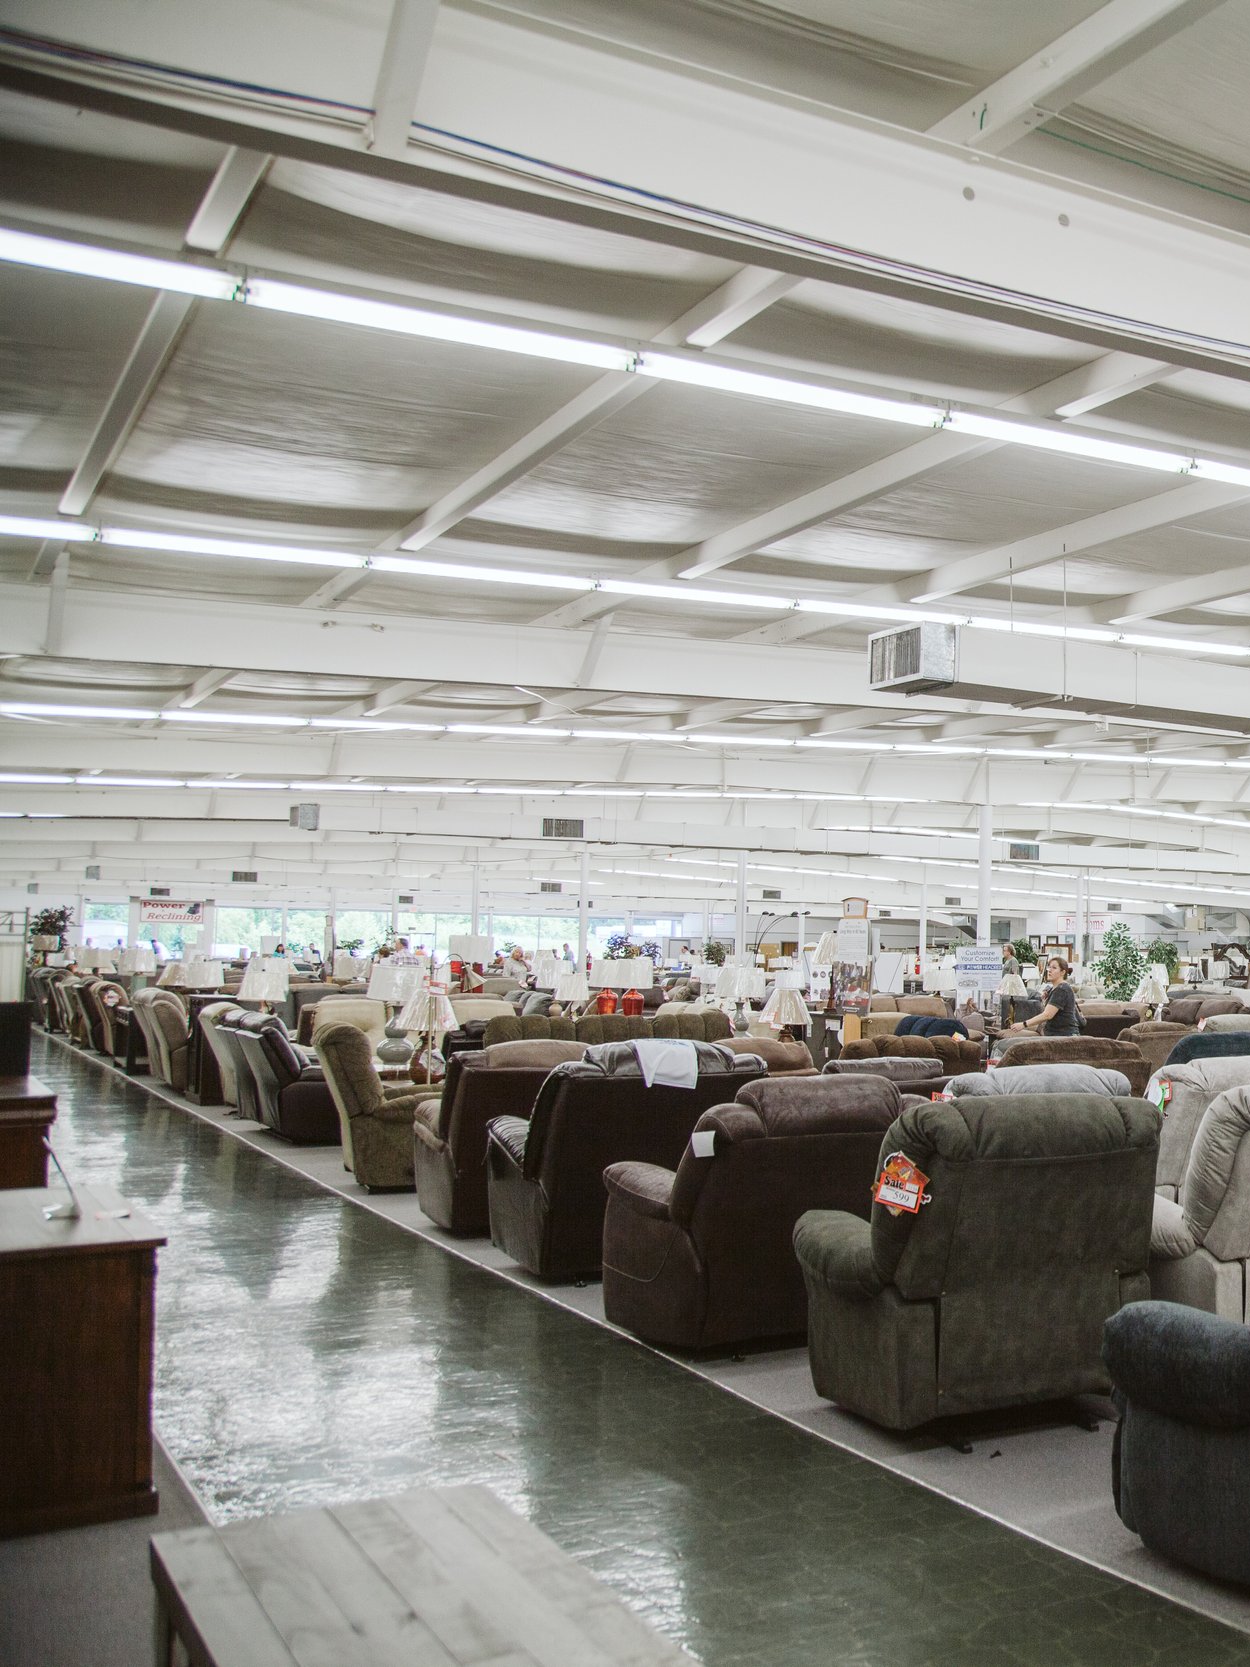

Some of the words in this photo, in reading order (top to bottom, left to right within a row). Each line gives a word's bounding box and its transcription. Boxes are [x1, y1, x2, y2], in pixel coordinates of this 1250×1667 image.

[143, 901, 185, 909] Power
[147, 912, 201, 922] Reclining
[884, 1176, 904, 1189] Sale
[894, 1190, 910, 1203] 599
